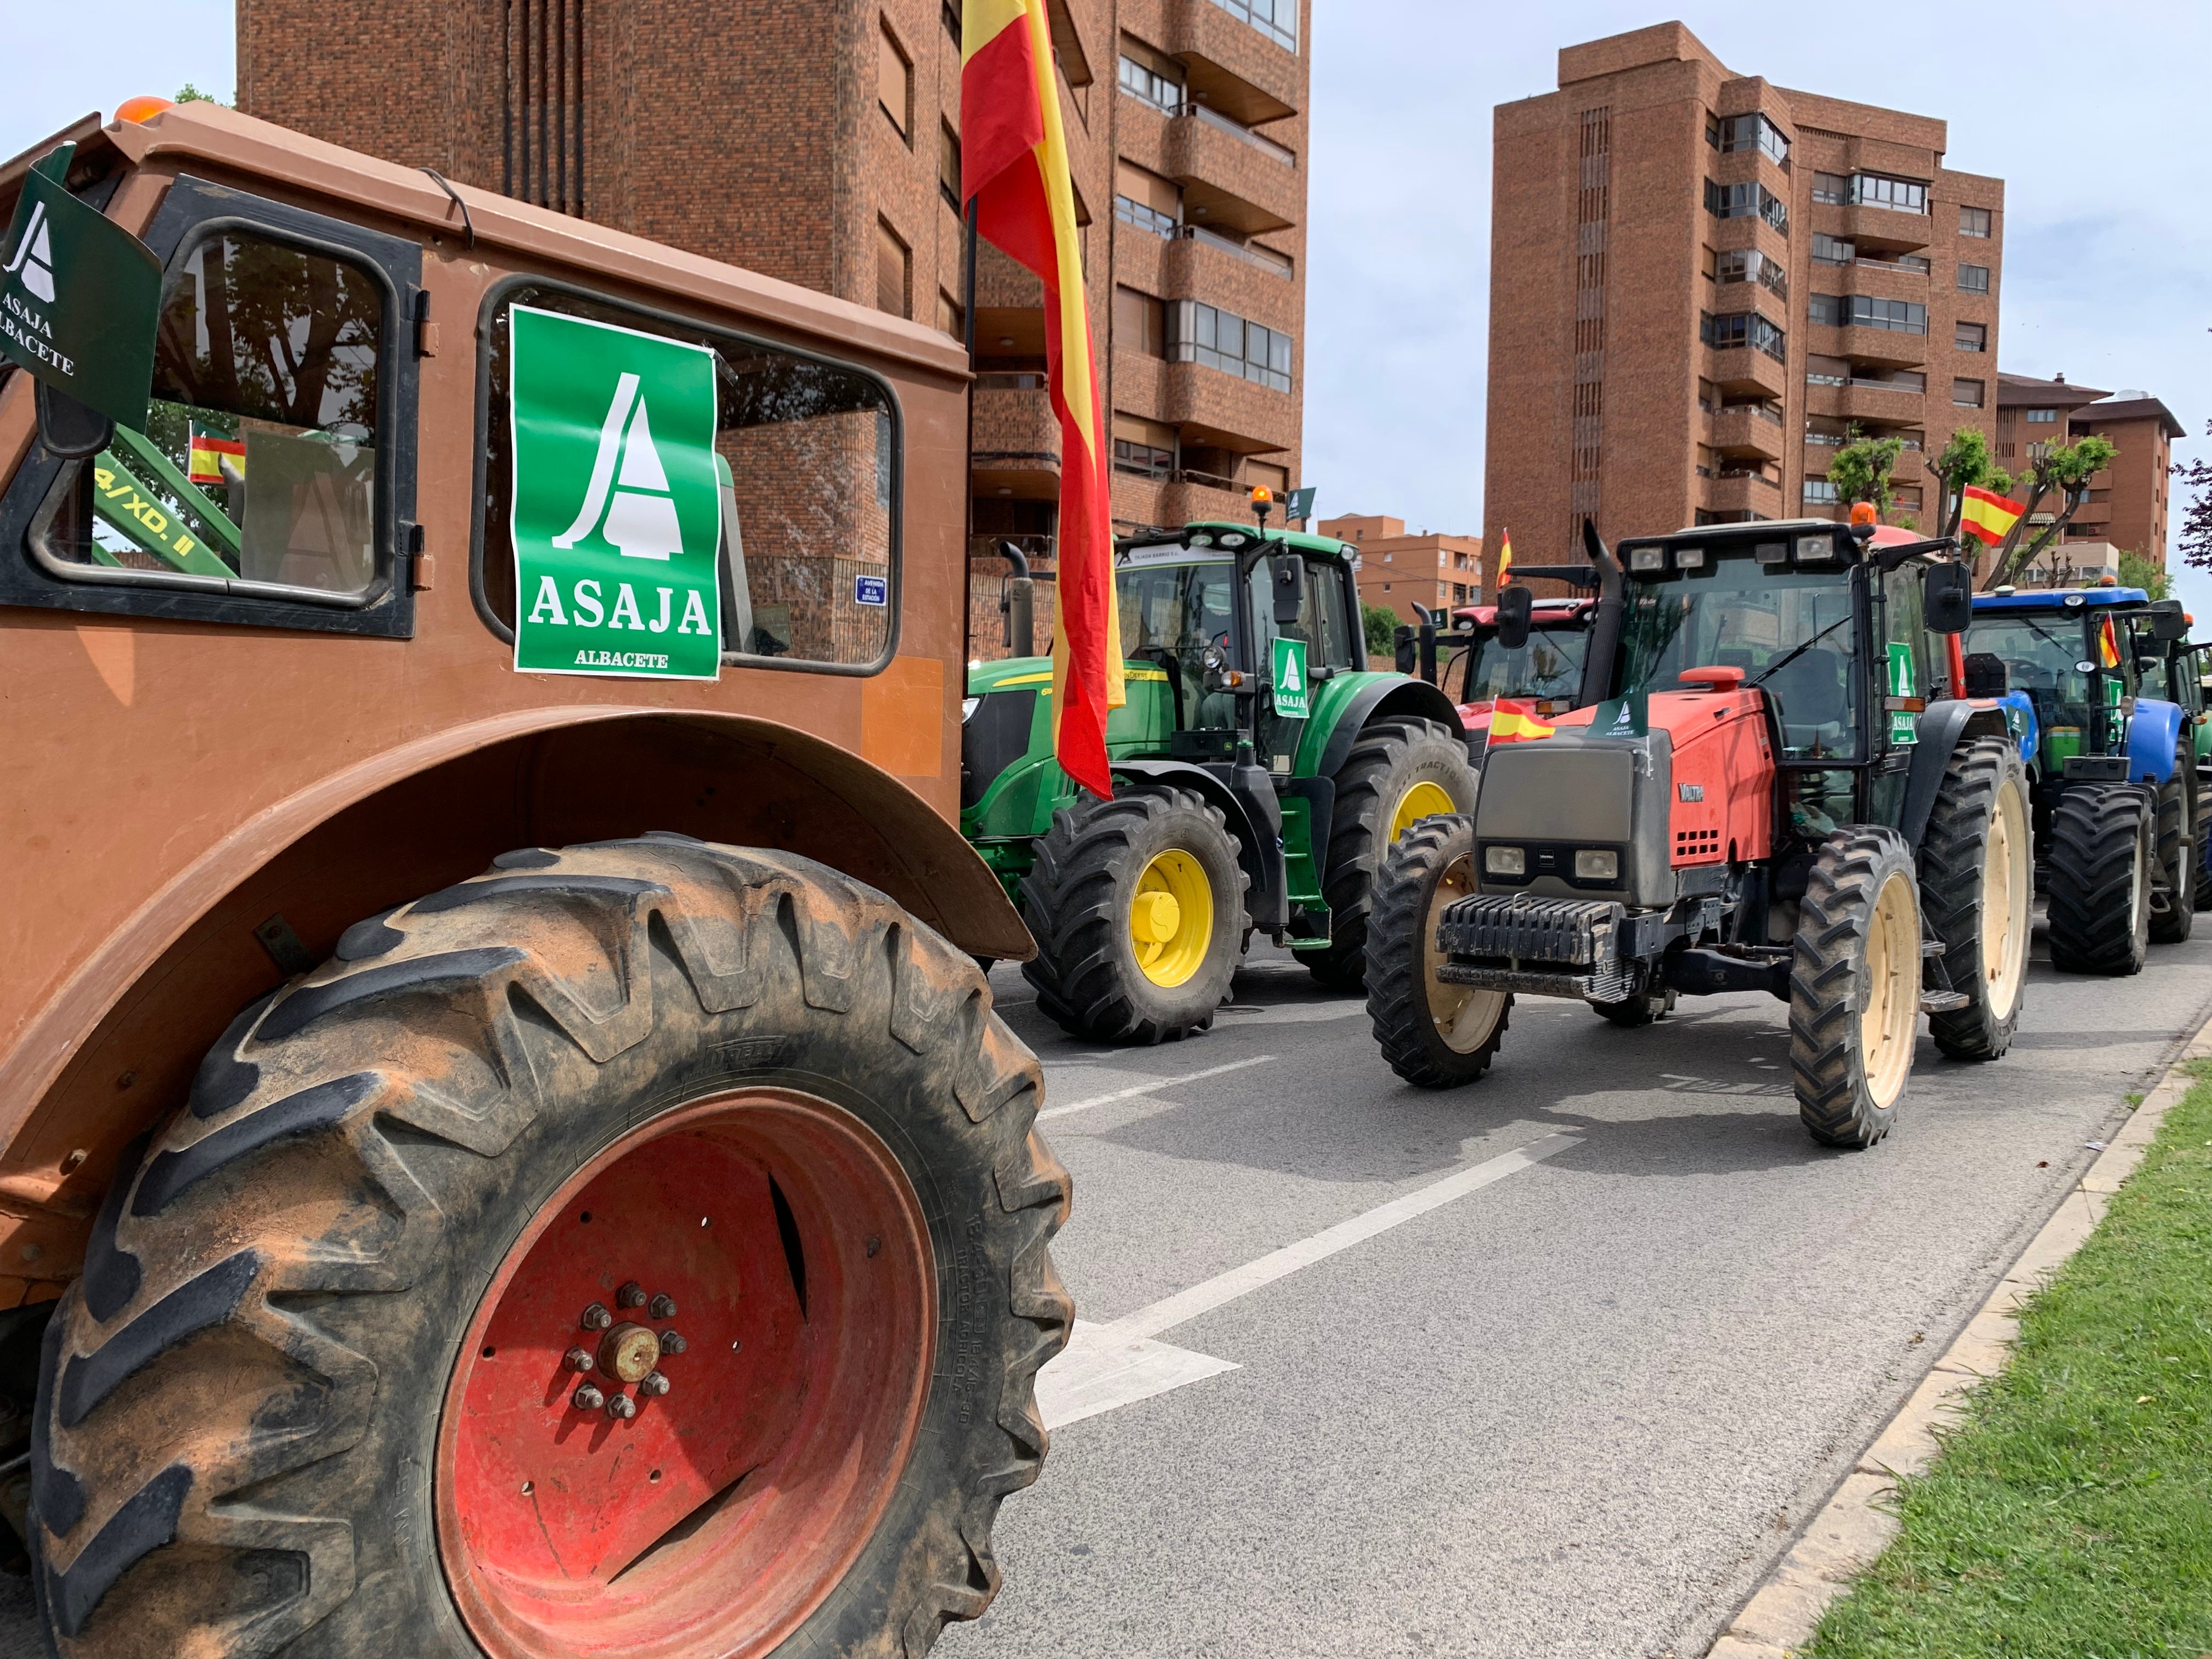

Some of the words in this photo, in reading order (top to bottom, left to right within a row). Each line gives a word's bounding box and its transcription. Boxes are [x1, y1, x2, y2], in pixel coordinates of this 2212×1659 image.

[3, 292, 53, 340] ASAJA
[0, 311, 74, 376] LBACETE
[864, 579, 884, 588] AVENIDA
[528, 575, 712, 636] ASAJA
[574, 650, 669, 669] ALBACETE
[1276, 694, 1306, 708] ASAJA
[1893, 716, 1914, 731] ASAJA
[956, 1248, 970, 1313] TRACTOR
